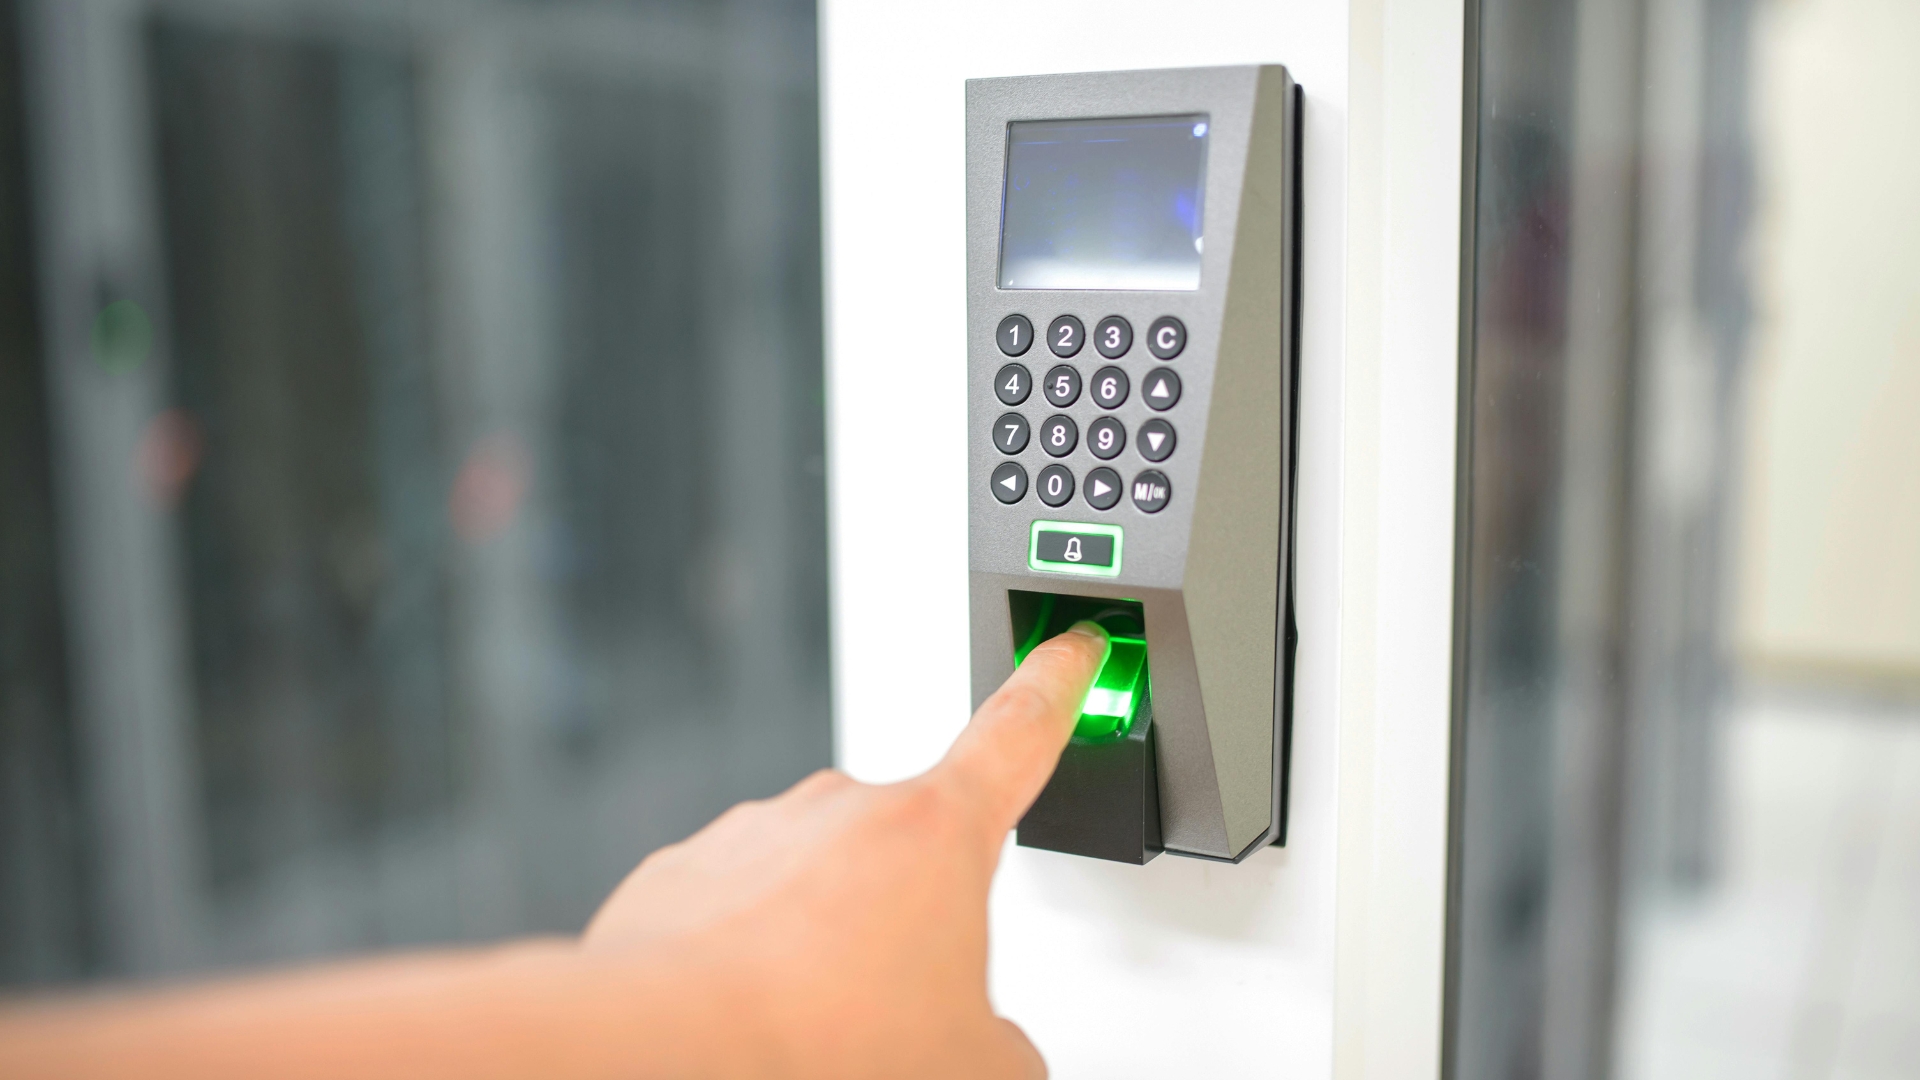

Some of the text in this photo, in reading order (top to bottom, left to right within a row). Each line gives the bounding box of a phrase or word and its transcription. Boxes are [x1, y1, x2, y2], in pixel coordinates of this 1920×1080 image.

[1009, 325, 1177, 349] 1 2 3 C
[1004, 374, 1117, 400] 4 5 6
[1004, 424, 1114, 450] 7 8 9
[1047, 475, 1062, 497] 0
